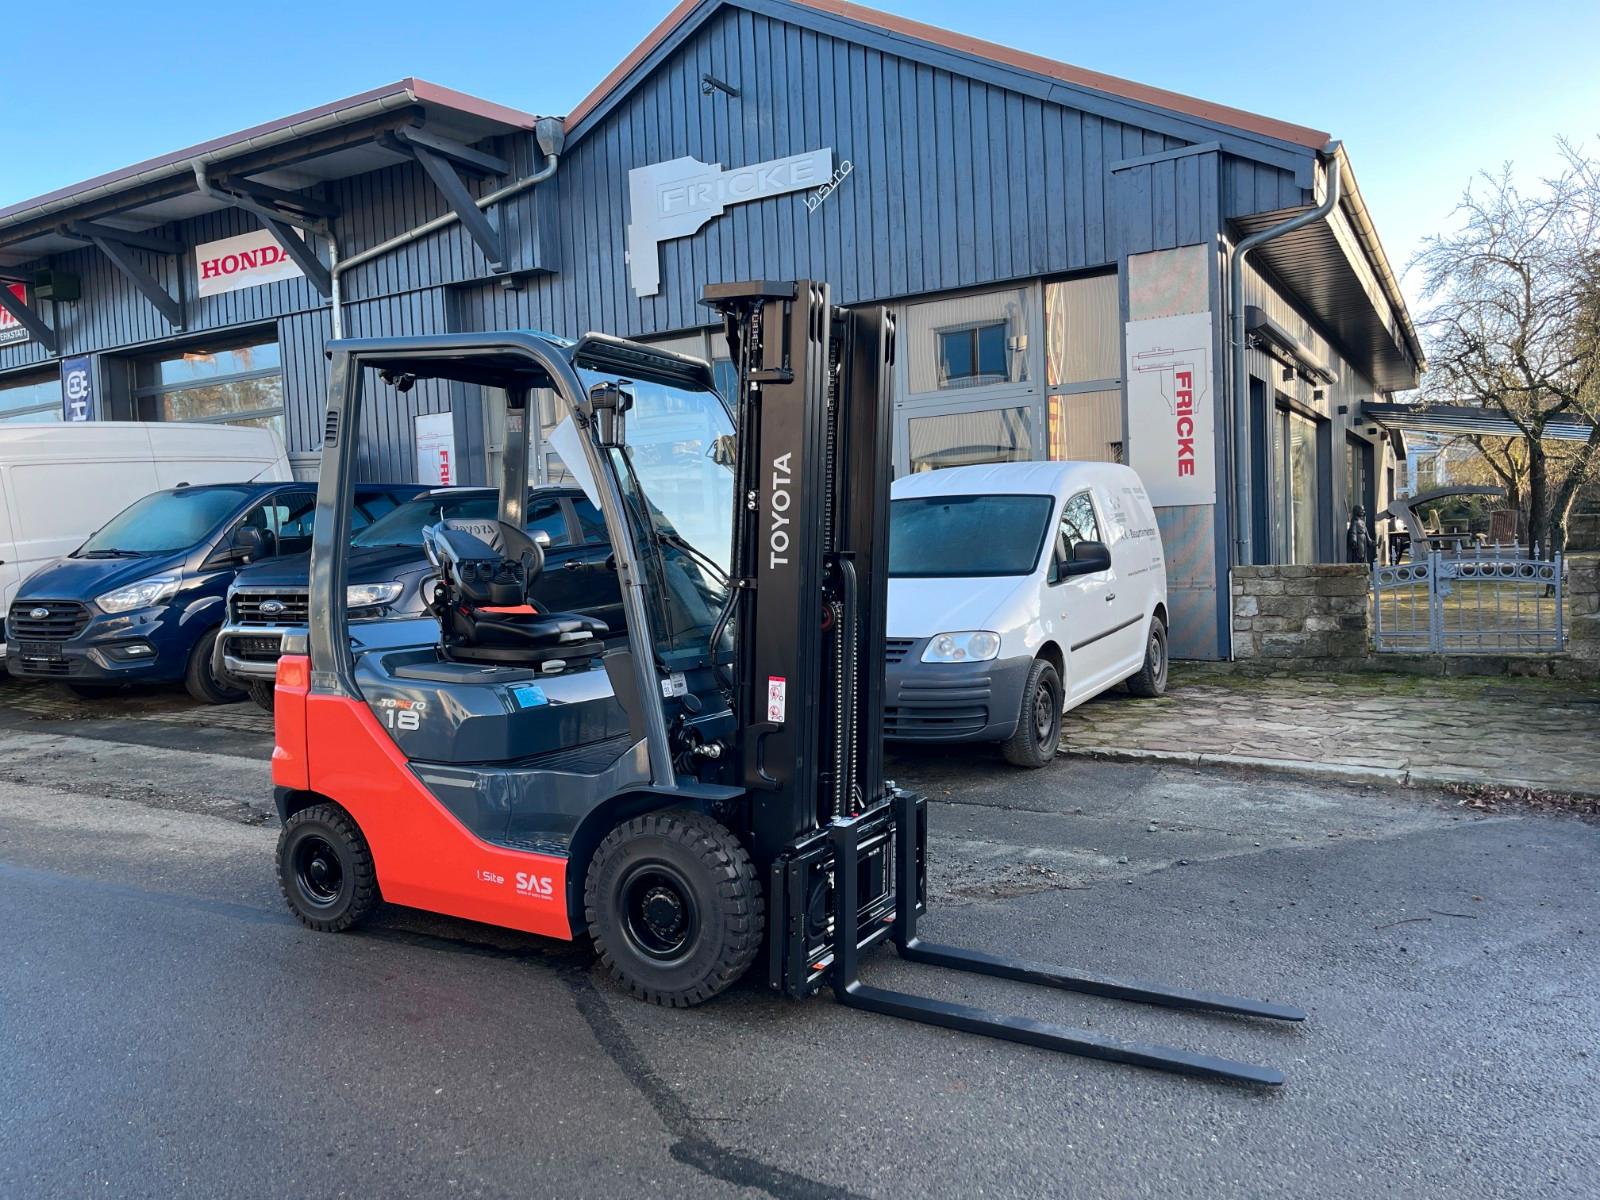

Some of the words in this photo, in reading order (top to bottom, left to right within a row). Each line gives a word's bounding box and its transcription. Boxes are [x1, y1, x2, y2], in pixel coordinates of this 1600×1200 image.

[662, 158, 815, 213] FRICKE
[1176, 371, 1194, 477] FRICKE
[769, 451, 792, 570] TOYOTA
[385, 709, 420, 731] 18
[515, 871, 553, 895] SAS
